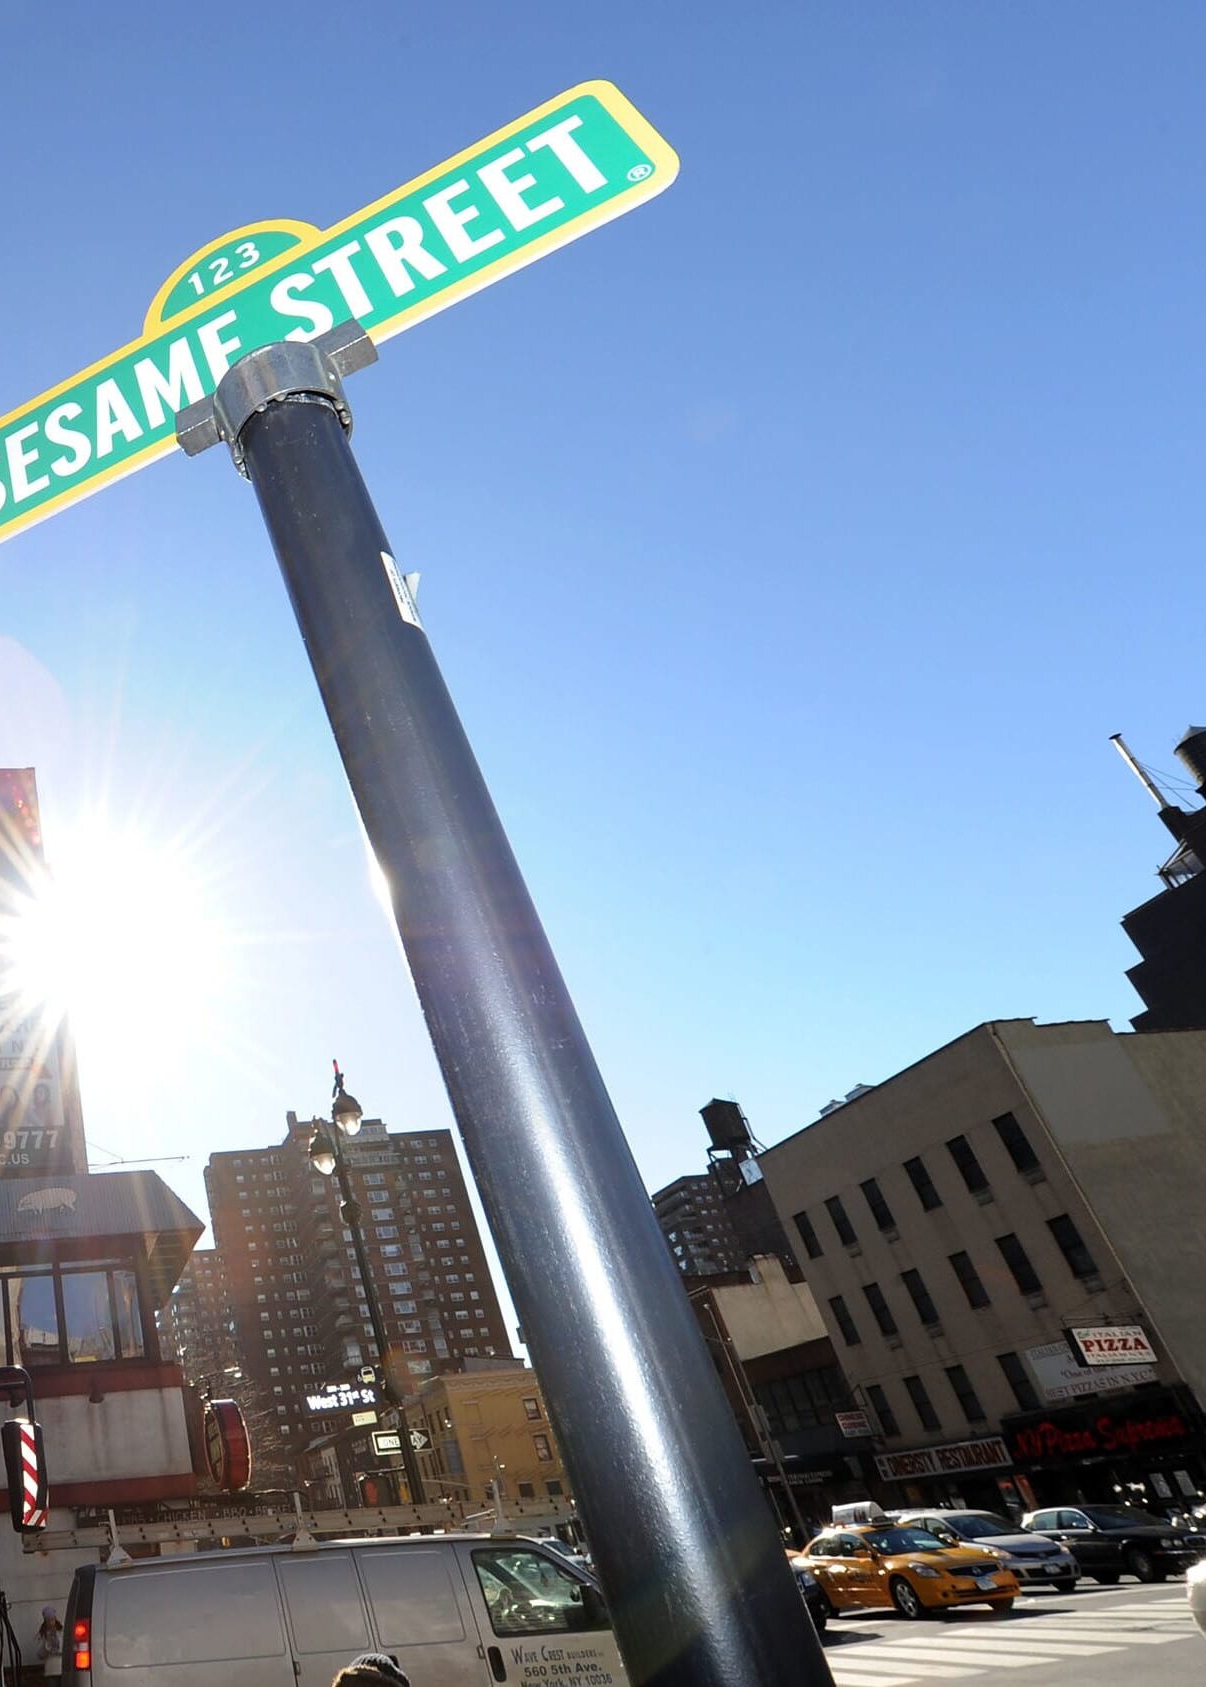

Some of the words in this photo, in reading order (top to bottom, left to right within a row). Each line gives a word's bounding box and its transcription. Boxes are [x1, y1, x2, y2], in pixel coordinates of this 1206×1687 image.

[270, 114, 610, 344] STREET
[187, 242, 261, 296] 123
[1081, 1337, 1149, 1353] PIZZA
[306, 1394, 340, 1411] West
[361, 1388, 376, 1404] St
[524, 1665, 547, 1678] 560
[550, 1663, 572, 1675] 5th
[575, 1663, 602, 1673] Ave.
